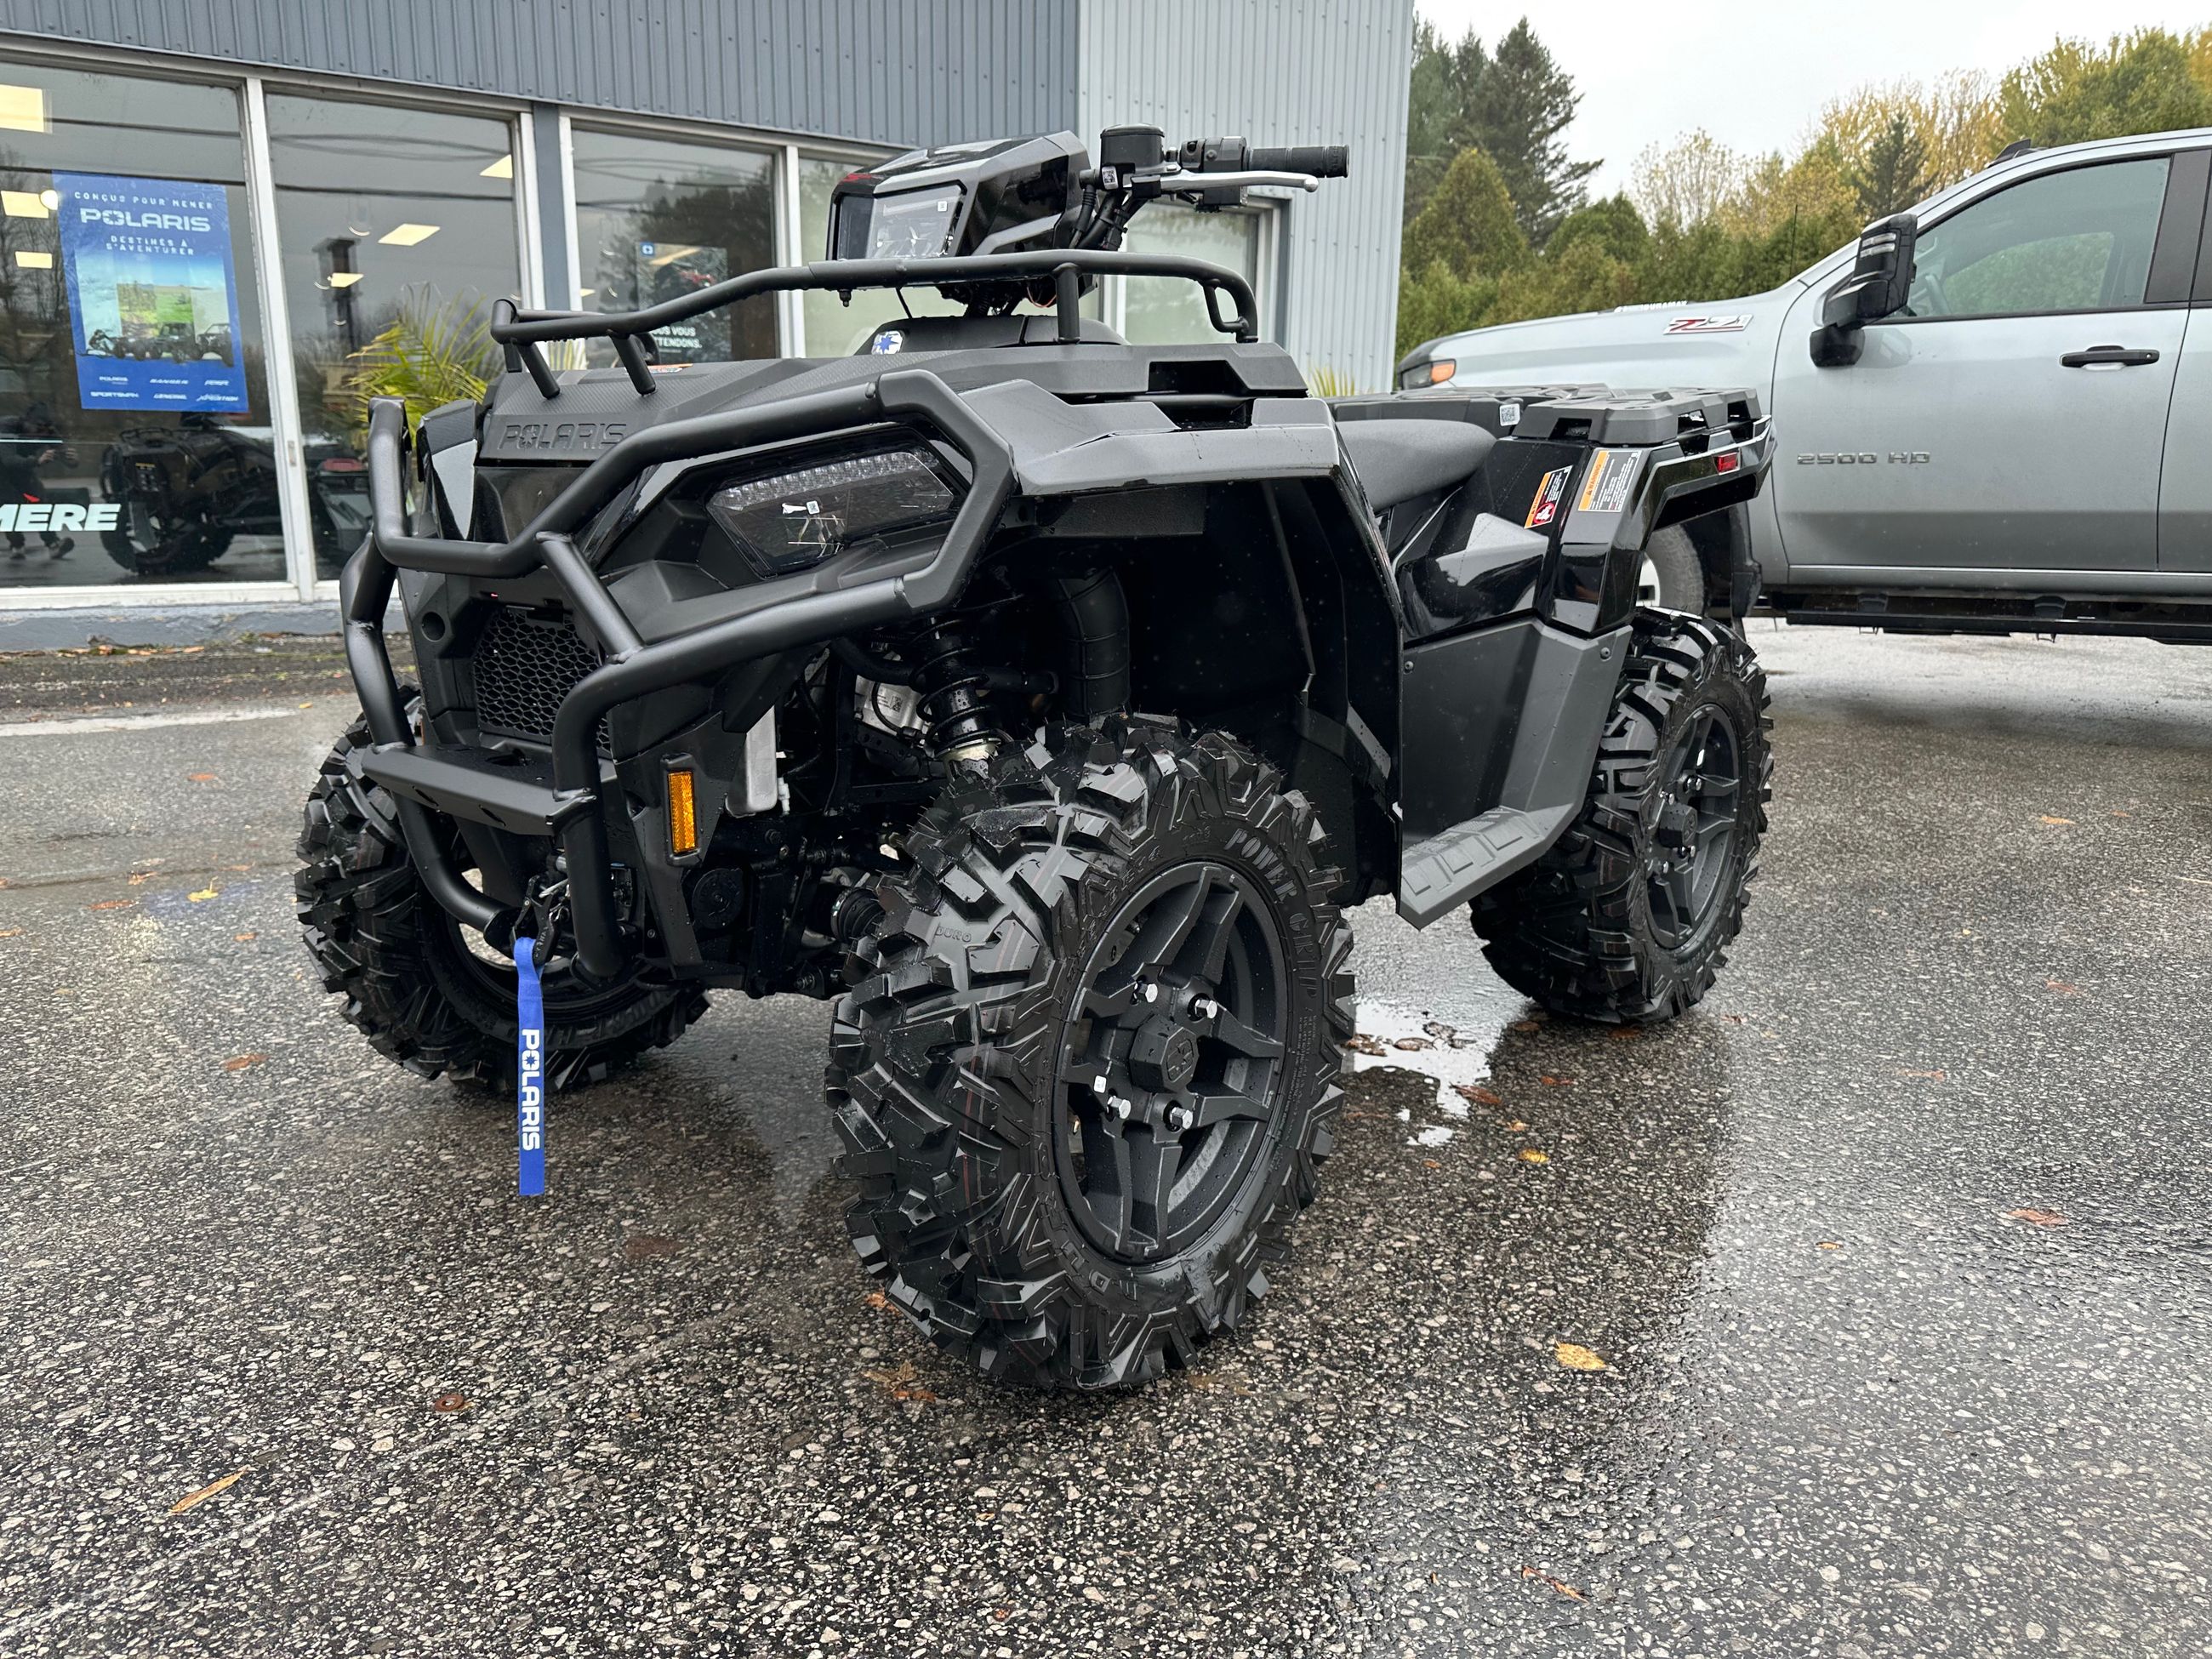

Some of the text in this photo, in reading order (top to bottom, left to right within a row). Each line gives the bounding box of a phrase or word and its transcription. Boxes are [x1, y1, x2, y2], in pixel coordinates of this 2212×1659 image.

[74, 191, 213, 209] CONÇUS POUR MENER
[80, 208, 211, 232] POLARIS
[1663, 314, 1753, 335] Z71
[497, 424, 627, 449] POLARIS
[1797, 452, 1930, 465] 2500 HD
[1223, 828, 1298, 904] POWER
[936, 926, 972, 942] DURO
[522, 1029, 540, 1151] POLARIS
